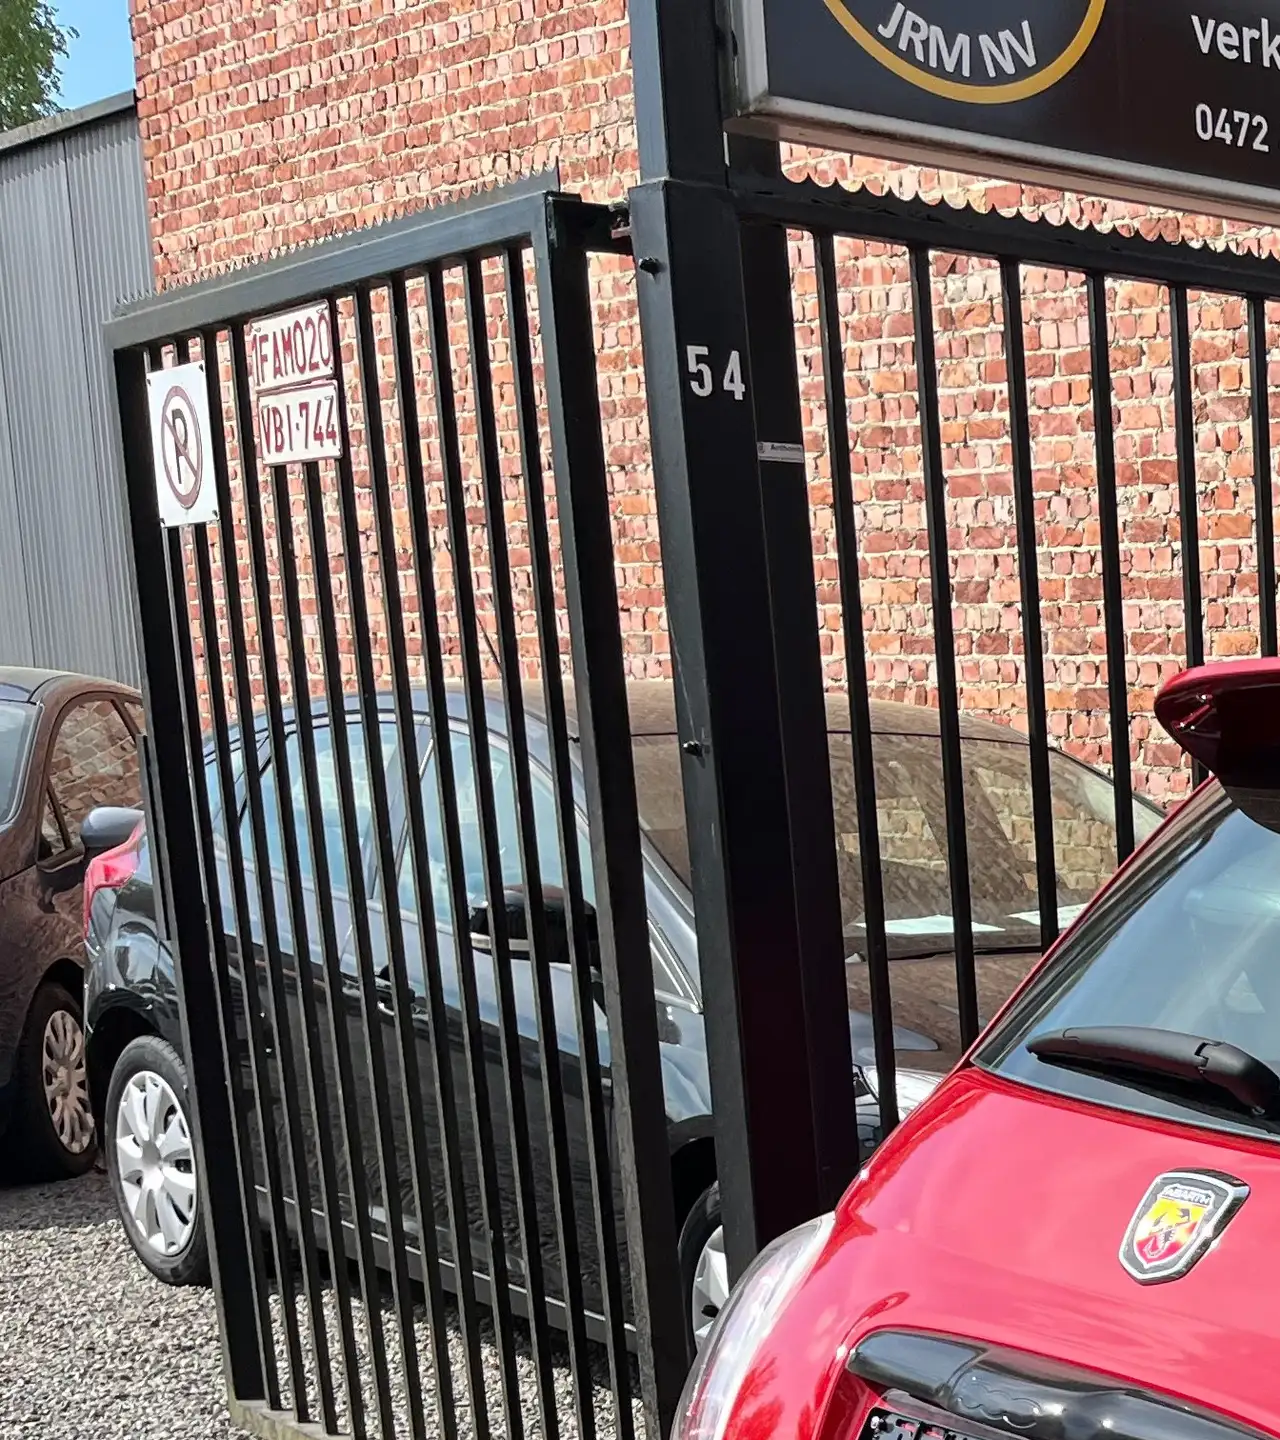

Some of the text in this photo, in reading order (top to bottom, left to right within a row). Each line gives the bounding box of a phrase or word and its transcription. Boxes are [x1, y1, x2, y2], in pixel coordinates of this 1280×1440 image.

[877, 2, 970, 78] JRM
[1195, 103, 1269, 152] 0472
[686, 344, 746, 401] 54
